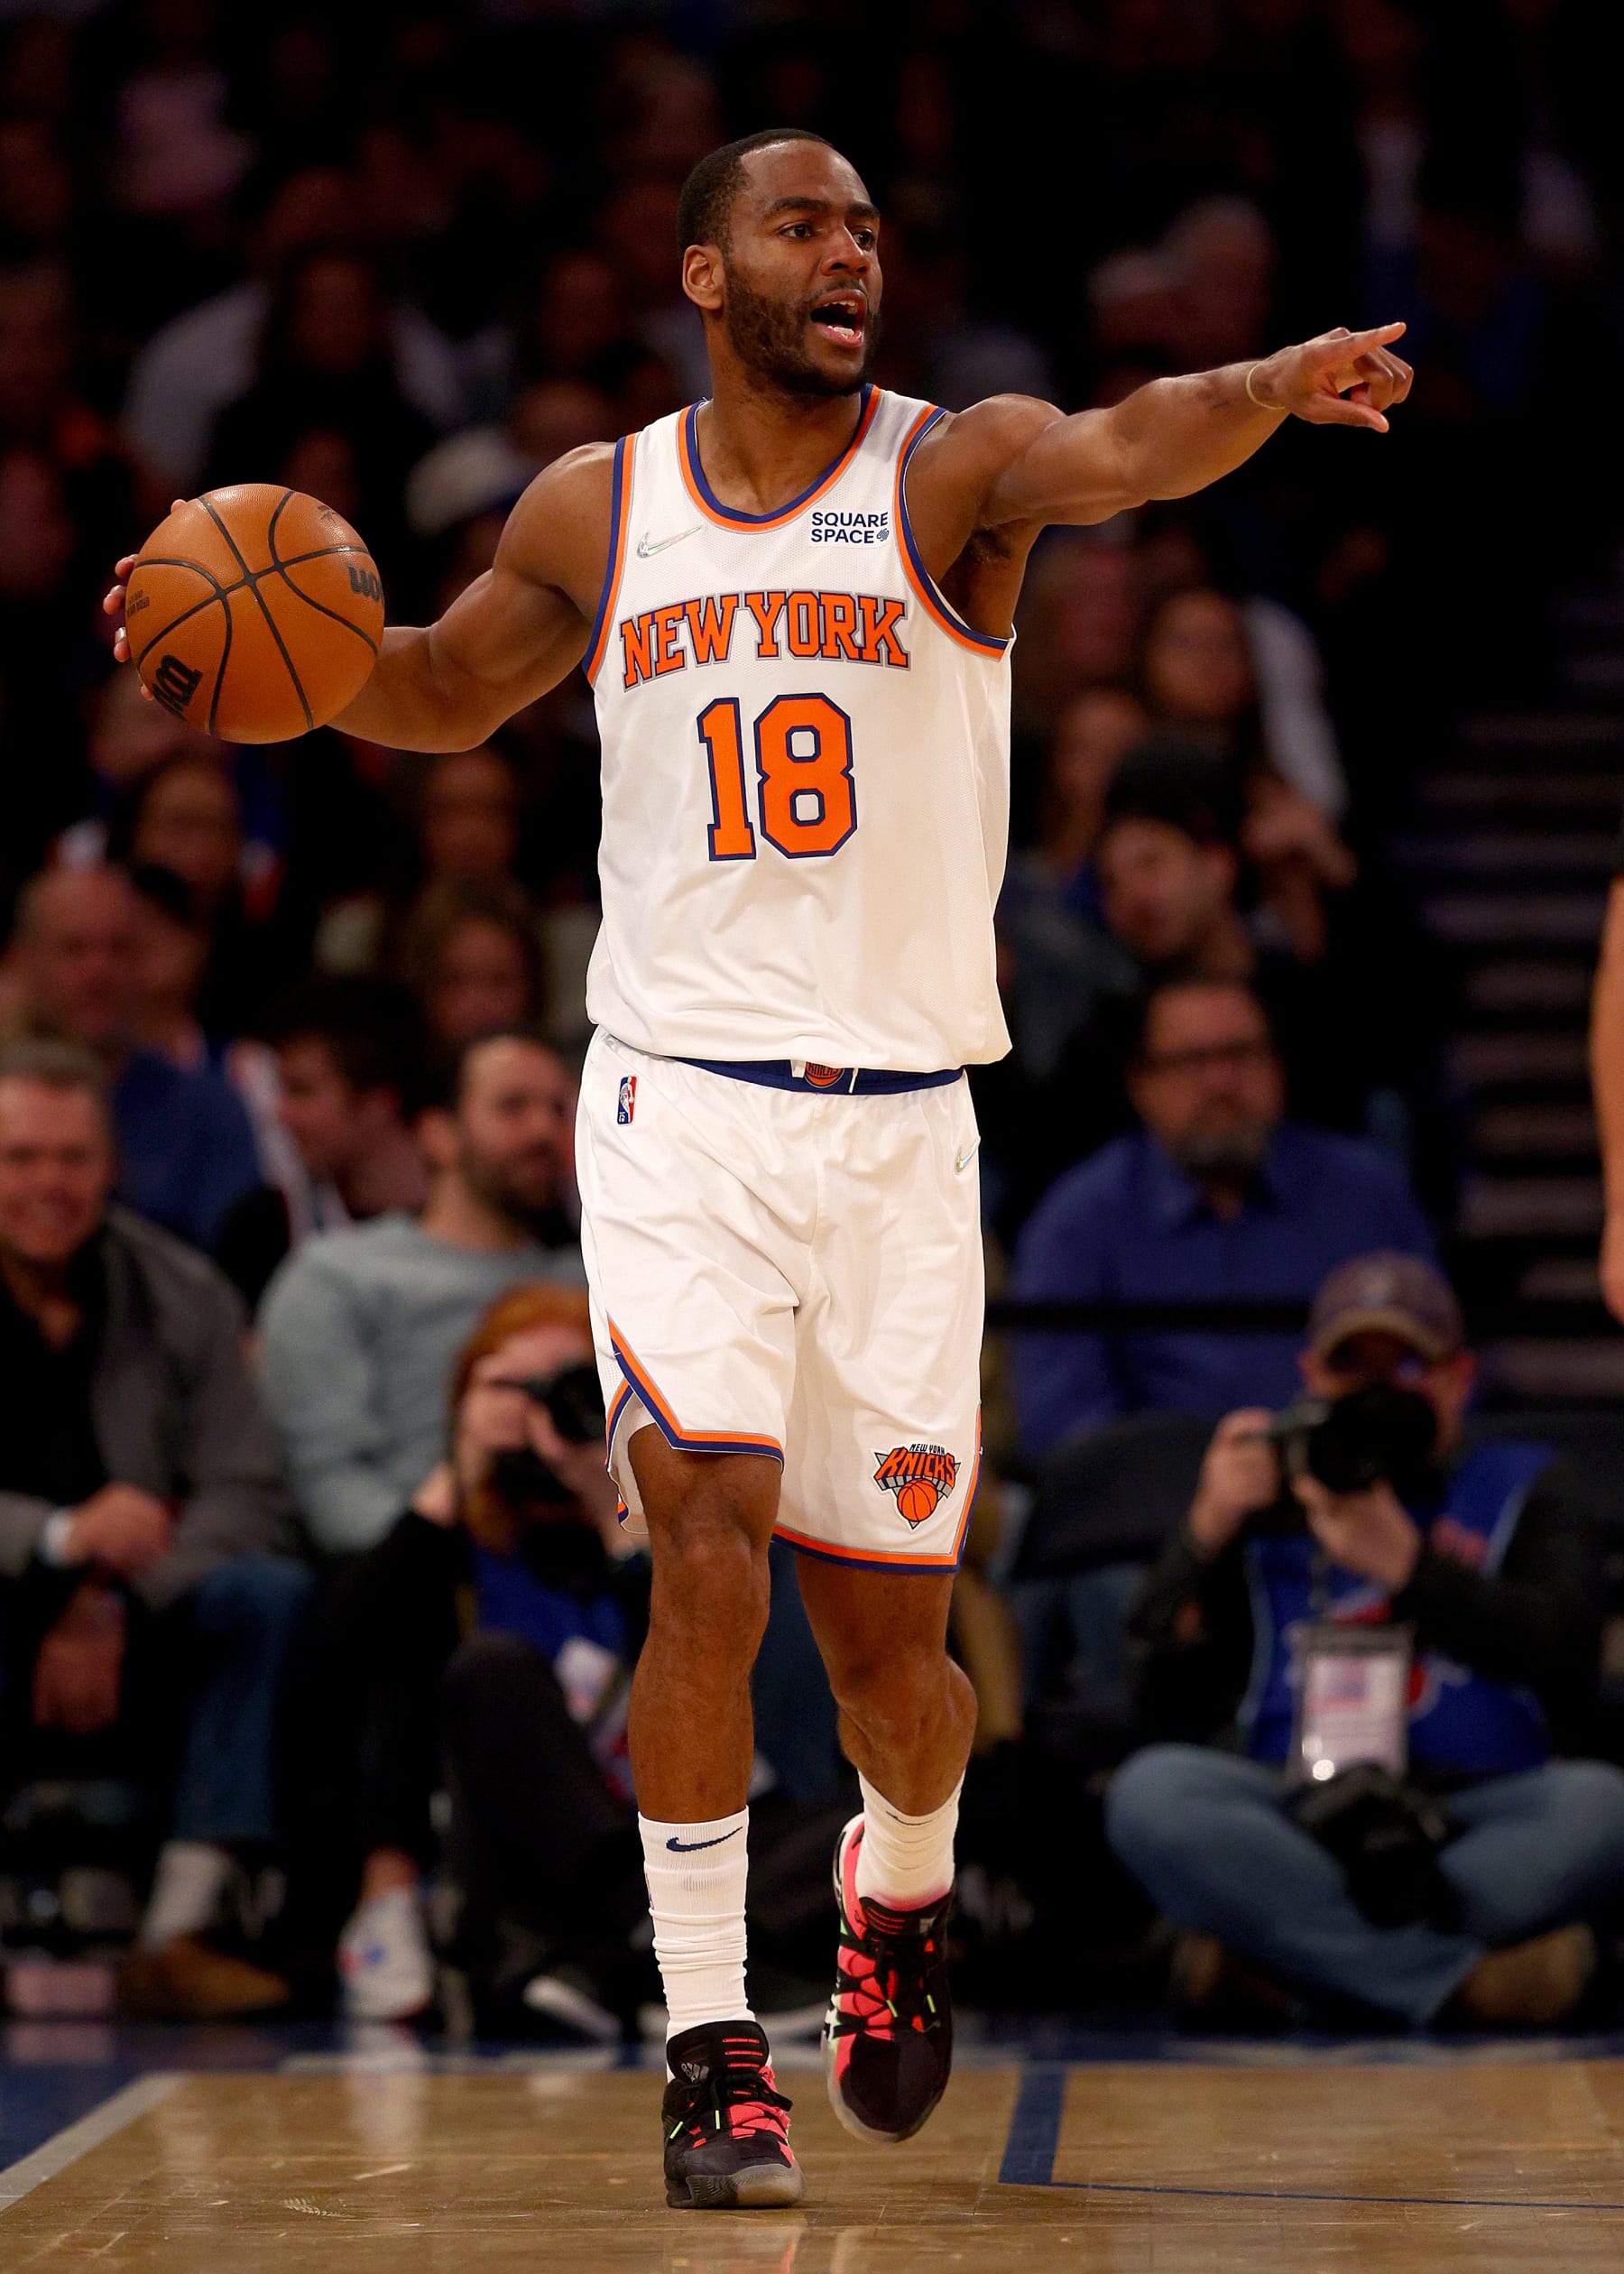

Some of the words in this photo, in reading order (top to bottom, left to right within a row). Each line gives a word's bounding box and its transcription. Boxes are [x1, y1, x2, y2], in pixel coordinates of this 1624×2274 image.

[811, 512, 889, 528] SQUARE
[811, 528, 875, 544] SPACE
[619, 592, 741, 692] NEW
[743, 589, 911, 671] YORK
[697, 692, 858, 861] 18
[909, 1443, 928, 1452] NEW
[873, 1447, 955, 1491] KNICKS
